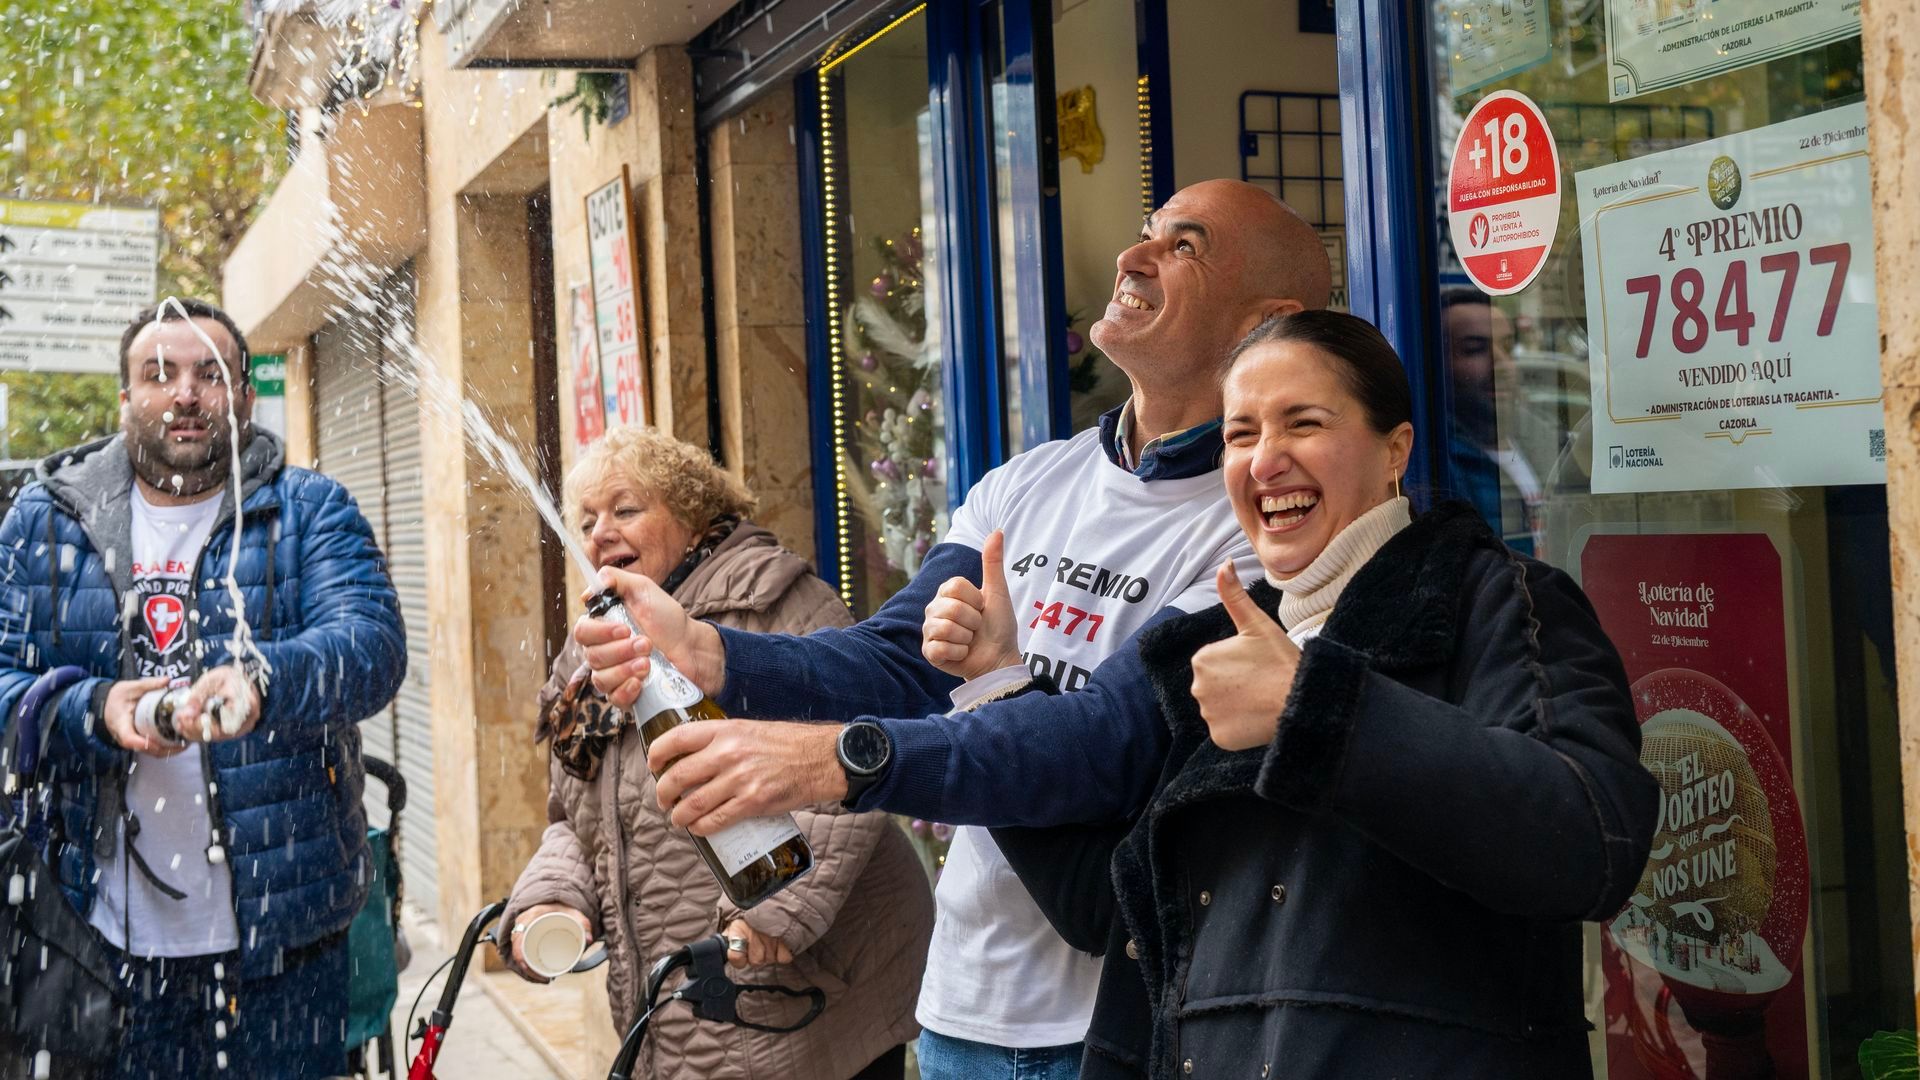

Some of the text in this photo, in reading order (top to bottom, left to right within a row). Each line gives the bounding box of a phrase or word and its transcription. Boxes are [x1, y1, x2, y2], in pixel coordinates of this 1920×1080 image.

[1662, 28, 1720, 53] ADMINISTRACIÓN
[1721, 26, 1730, 36] DE
[1731, 16, 1764, 33] LOTERIAS
[1765, 13, 1774, 23] LA
[1775, 0, 1814, 20] TRAGANTIA
[1721, 36, 1752, 51] CAZORLA
[1469, 112, 1529, 179] +18
[1799, 125, 1868, 149] 22 de Diciembr
[1459, 178, 1547, 202] JUEGA CON RESPONSABILIDAD
[1619, 180, 1628, 191] de
[1628, 169, 1662, 190] Navidad
[1492, 210, 1521, 222] PROHIBIDA
[1492, 225, 1500, 233] LA
[1500, 222, 1518, 232] VENTA
[1492, 229, 1540, 244] AUTOPROHIBIDOS
[1658, 203, 1803, 262] 4º PREMIO
[1626, 242, 1851, 359] 78477
[1678, 352, 1792, 388] VENDIDO AQUÍ
[1650, 389, 1834, 415] ADMINISTRACIÓN DE LOTERIAS LA TRAGANTIA
[1719, 417, 1757, 430] CAZORLA
[1625, 445, 1656, 458] LOTERÍA
[1625, 457, 1664, 468] NACIONAL
[1056, 557, 1150, 604] REMIO
[1638, 581, 1715, 605] Lotería de
[1030, 600, 1104, 642] 7477
[1650, 603, 1715, 628] Navidad
[1651, 633, 1710, 648] 22 de Diciembre
[1678, 751, 1704, 785] EL
[1679, 830, 1699, 851] QUE
[1652, 838, 1737, 900] NOS UNE
